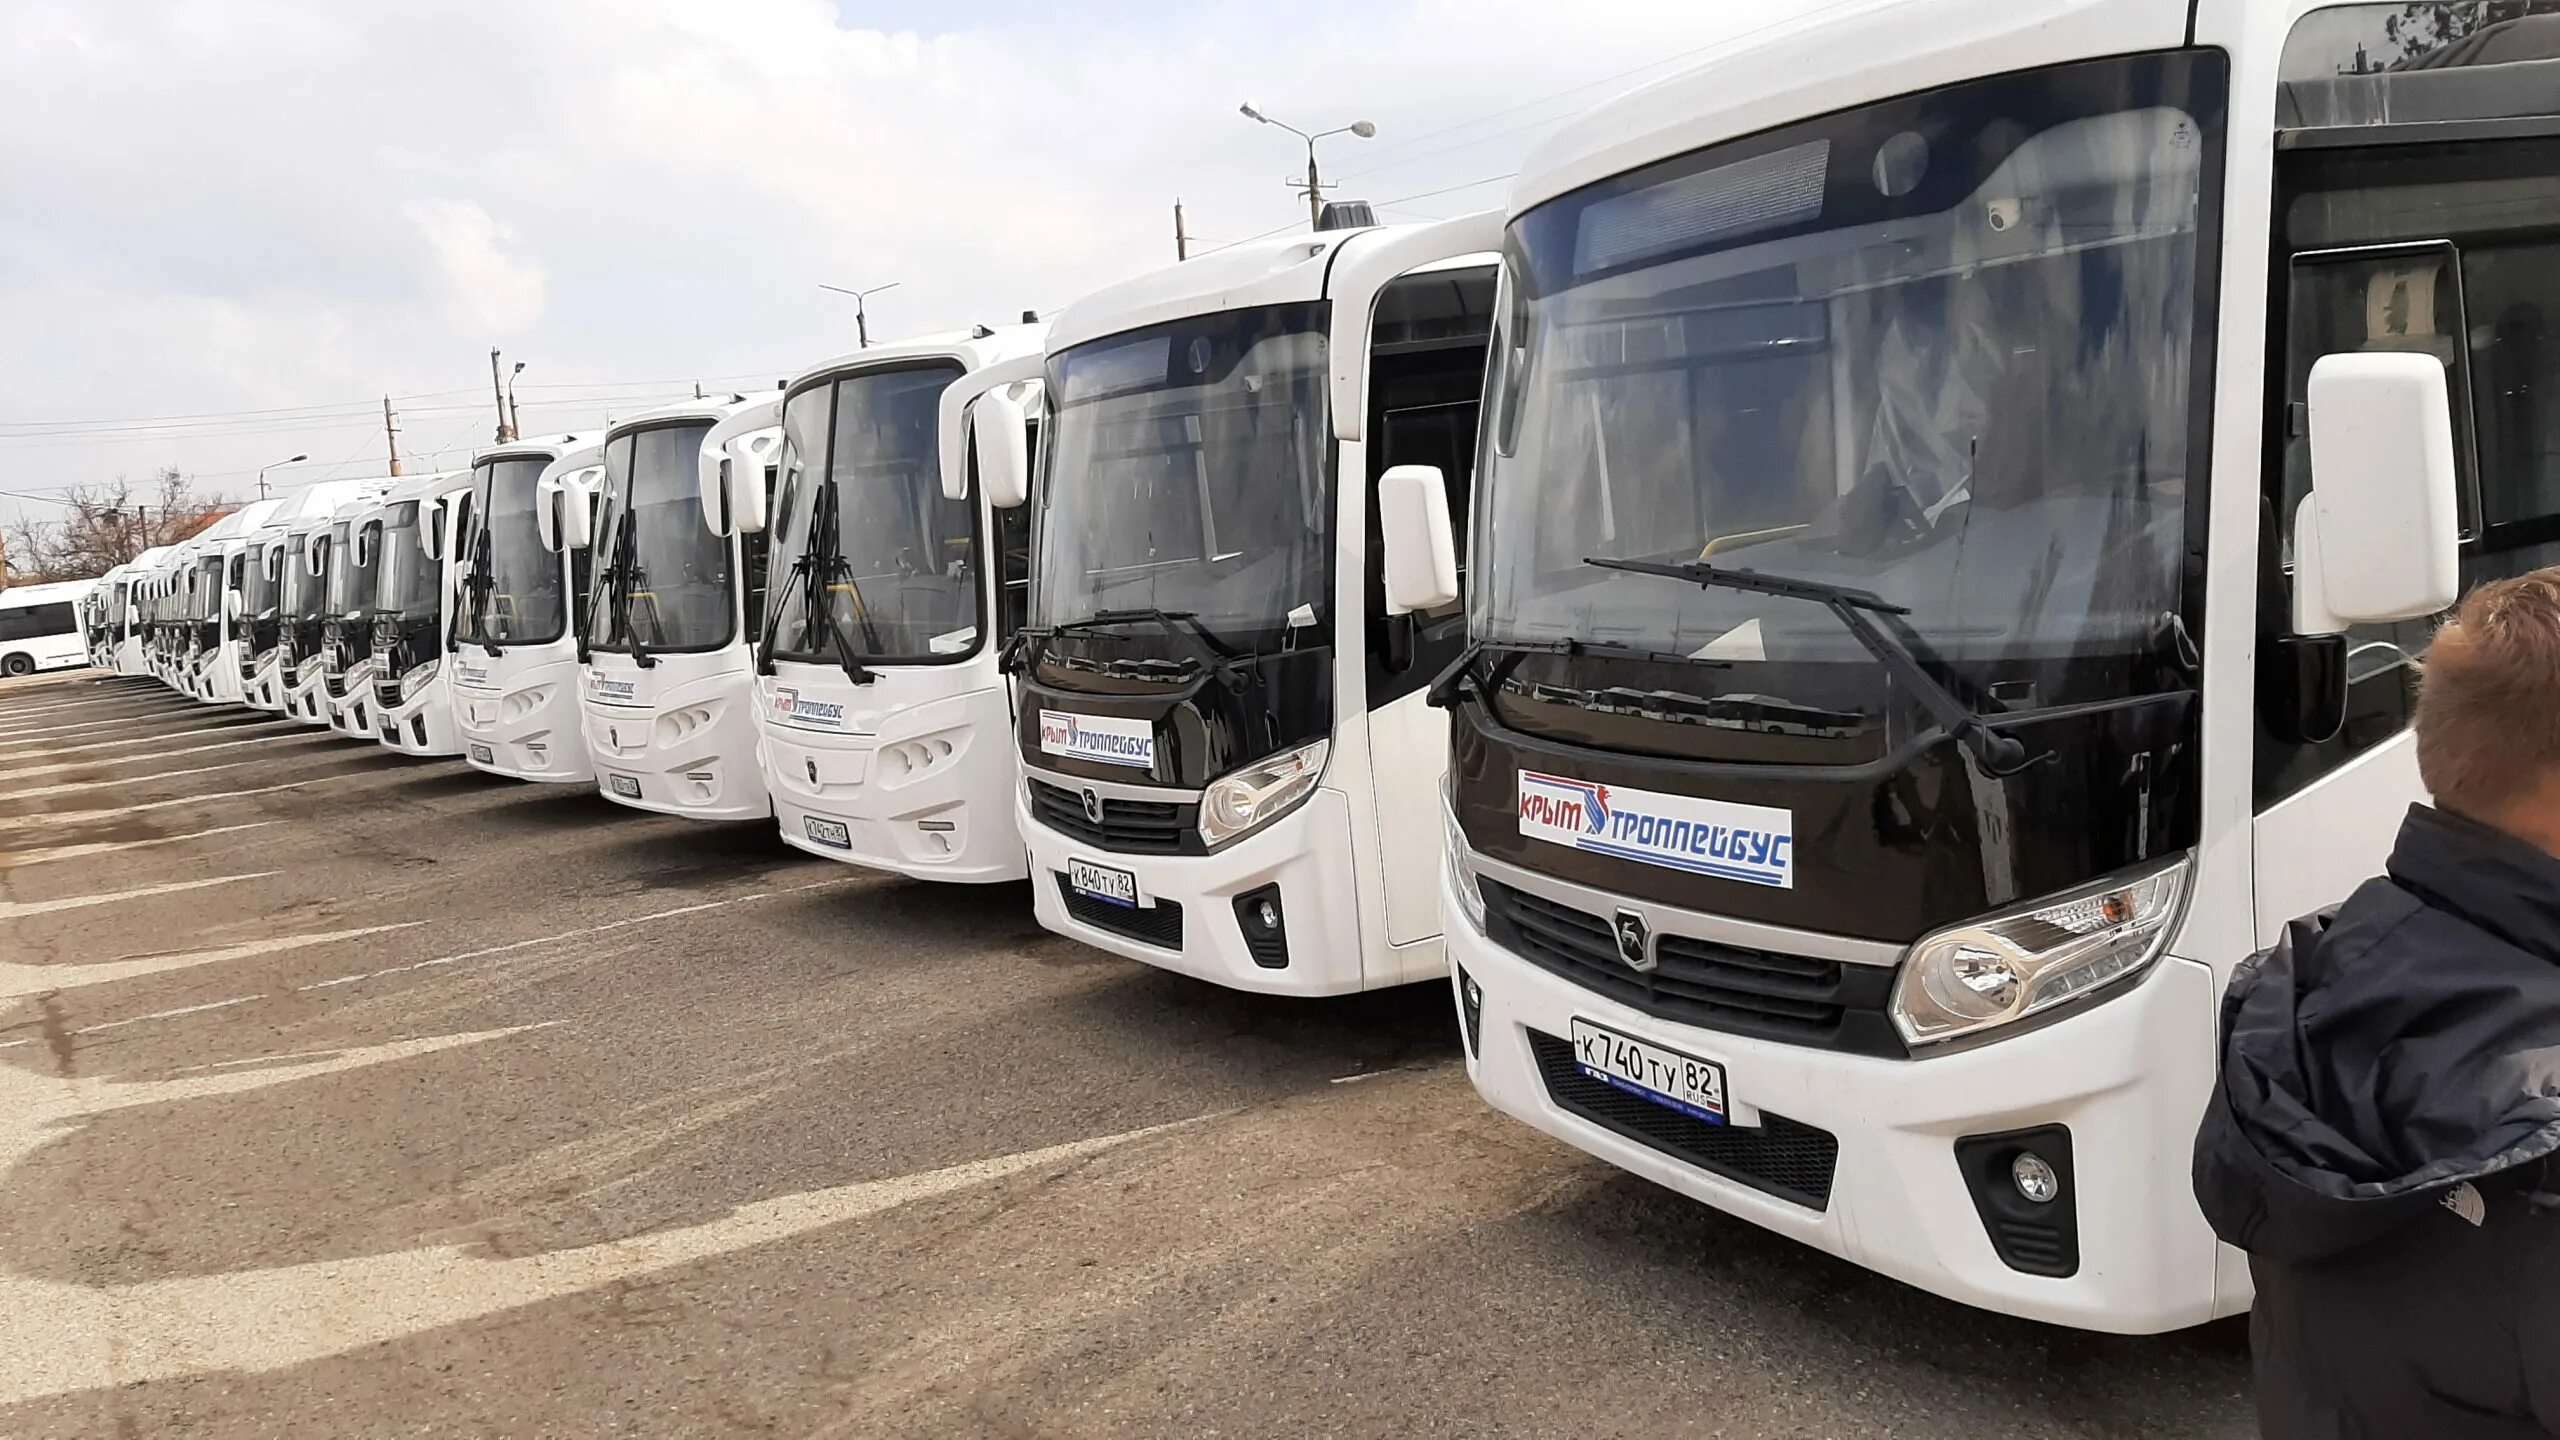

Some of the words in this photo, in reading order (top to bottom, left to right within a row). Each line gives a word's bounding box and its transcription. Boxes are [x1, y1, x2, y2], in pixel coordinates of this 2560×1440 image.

[1079, 731, 1153, 757] ТРОЛЛЕЙБУС
[1519, 791, 1581, 831] КРЫМ
[1611, 809, 1791, 868] ТРОЛЛЕЙБУС
[1686, 1062, 1713, 1096] 82
[1686, 1090, 1706, 1106] RUS
